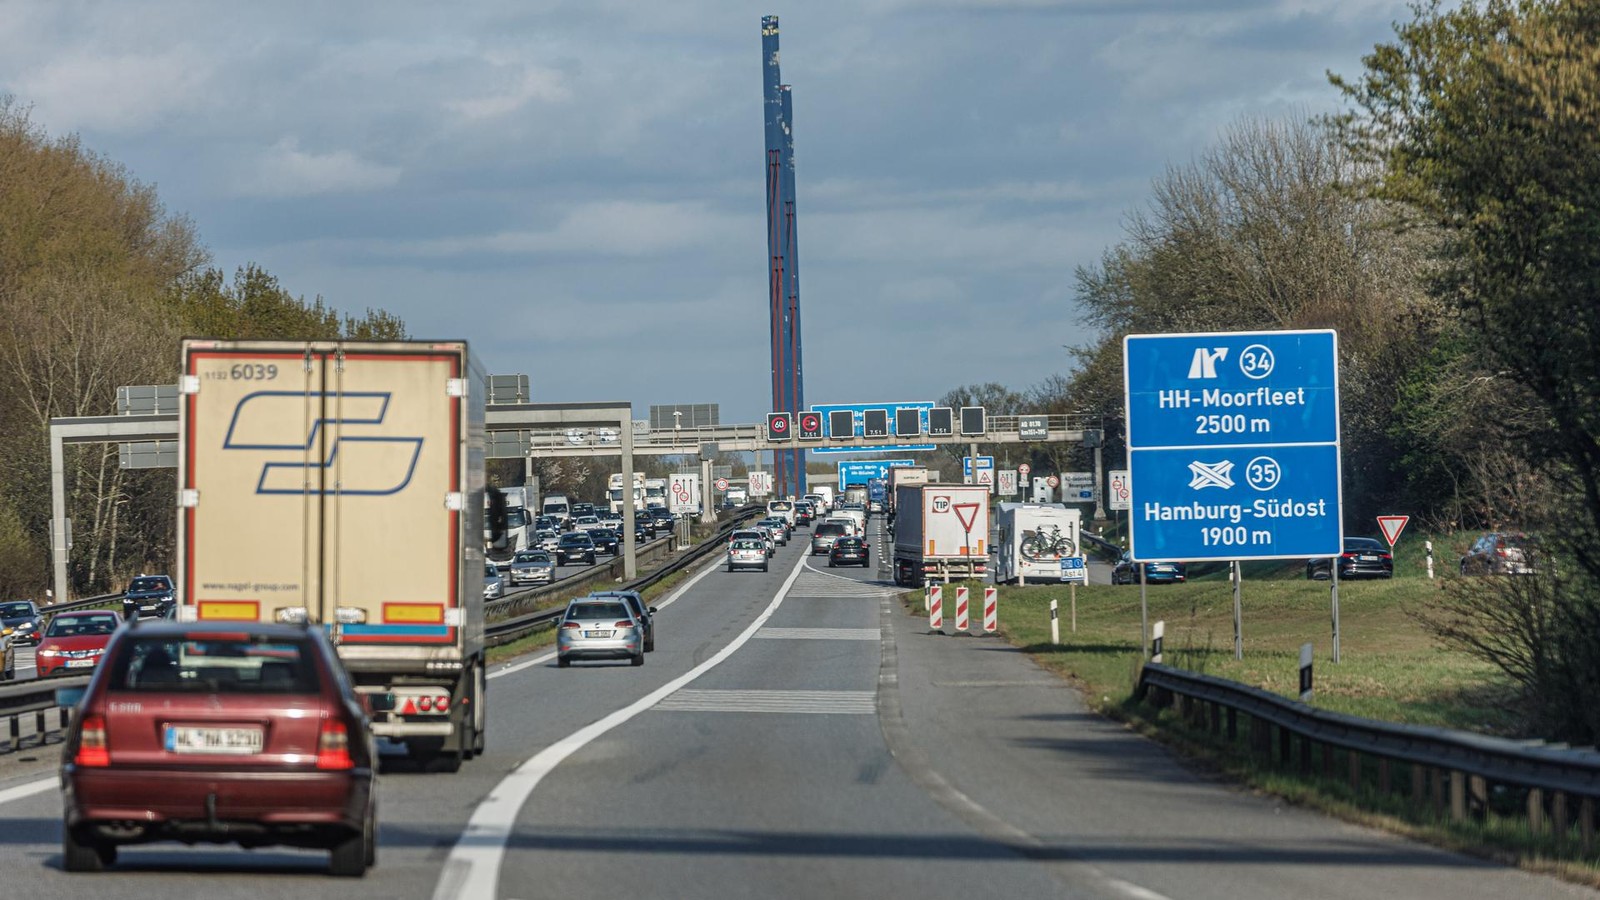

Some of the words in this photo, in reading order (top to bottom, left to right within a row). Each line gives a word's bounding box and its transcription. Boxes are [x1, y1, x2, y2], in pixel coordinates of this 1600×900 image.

[230, 363, 279, 380] 6039
[1244, 352, 1270, 372] 34
[1159, 387, 1305, 409] HH-Moorfleet
[774, 420, 784, 429] 60
[1195, 414, 1246, 434] 2500
[1250, 418, 1271, 433] m
[1251, 464, 1276, 483] 35
[934, 501, 948, 509] TIP
[1144, 498, 1326, 524] Hamburg-Südost
[1201, 527, 1248, 546] 1900
[1252, 530, 1272, 545] m
[202, 582, 299, 592] www.nagel-group.com
